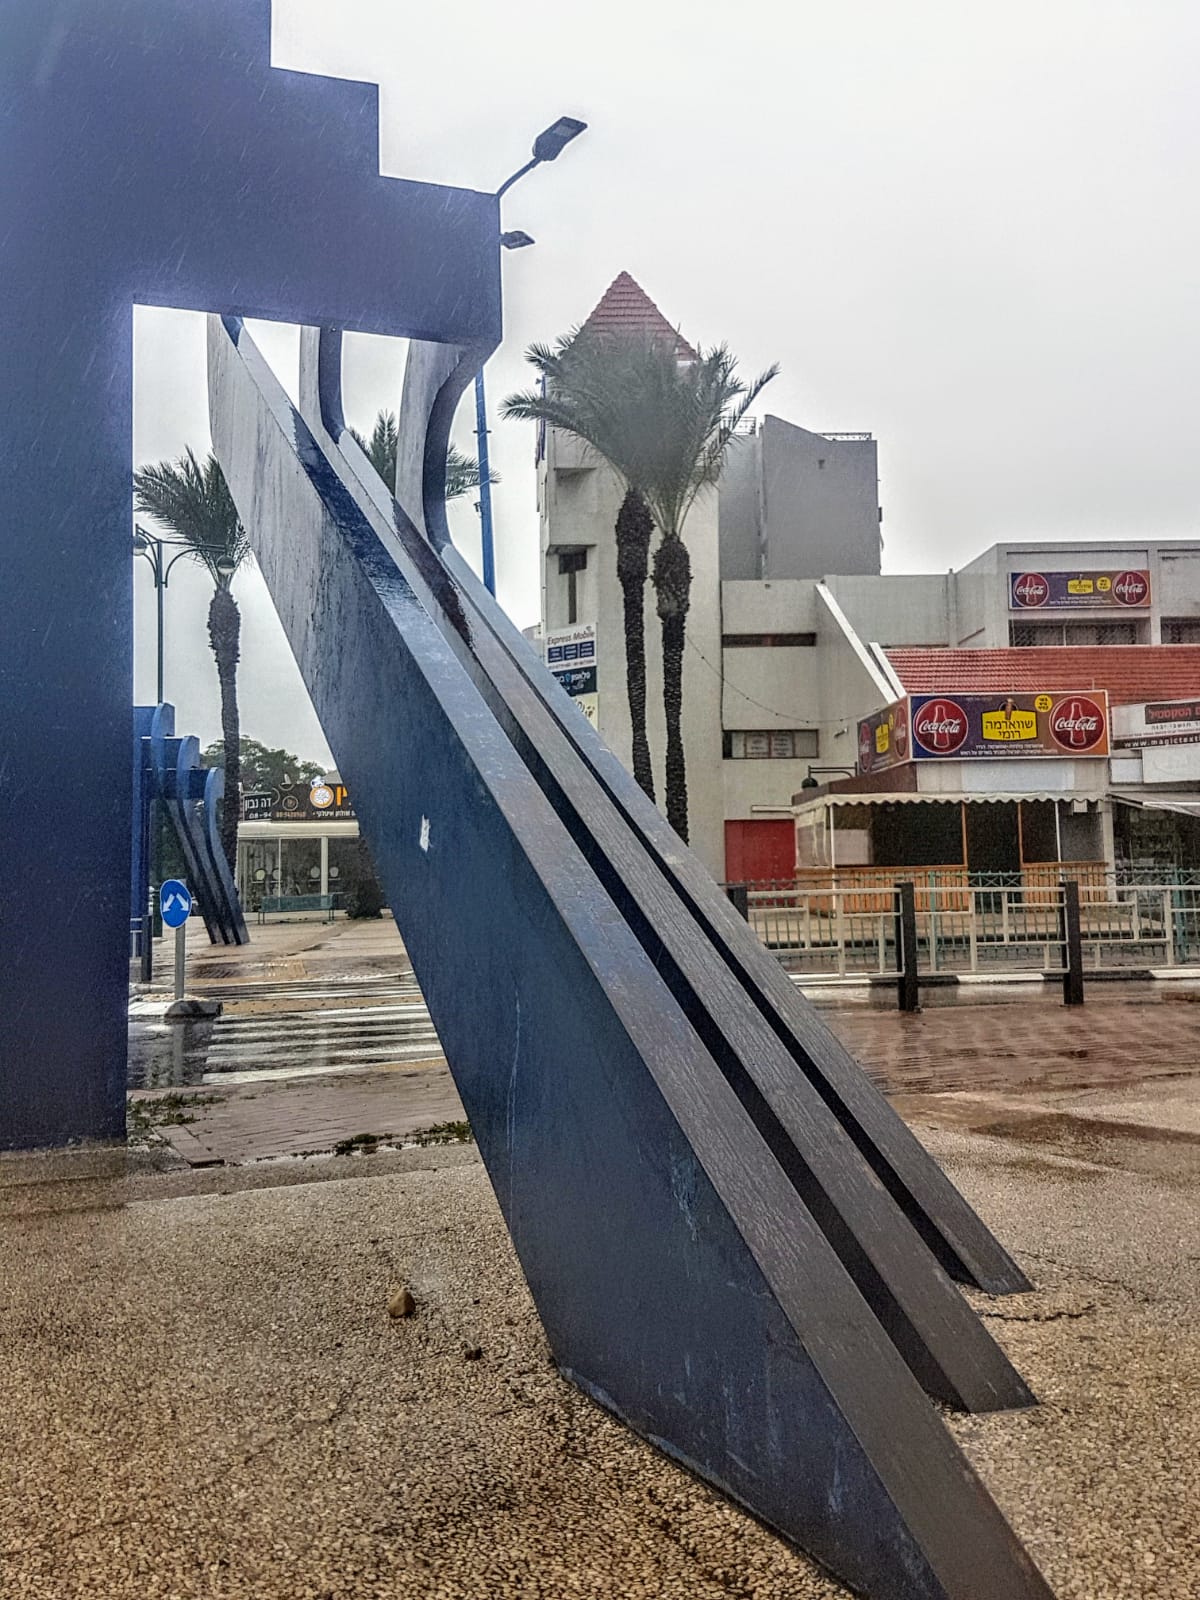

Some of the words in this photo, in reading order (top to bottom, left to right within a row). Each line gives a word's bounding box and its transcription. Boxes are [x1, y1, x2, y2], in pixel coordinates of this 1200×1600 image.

[547, 635, 571, 645] Express
[573, 630, 595, 640] Mobile
[985, 719, 1034, 730] שווארמה
[998, 730, 1021, 739] רומי
